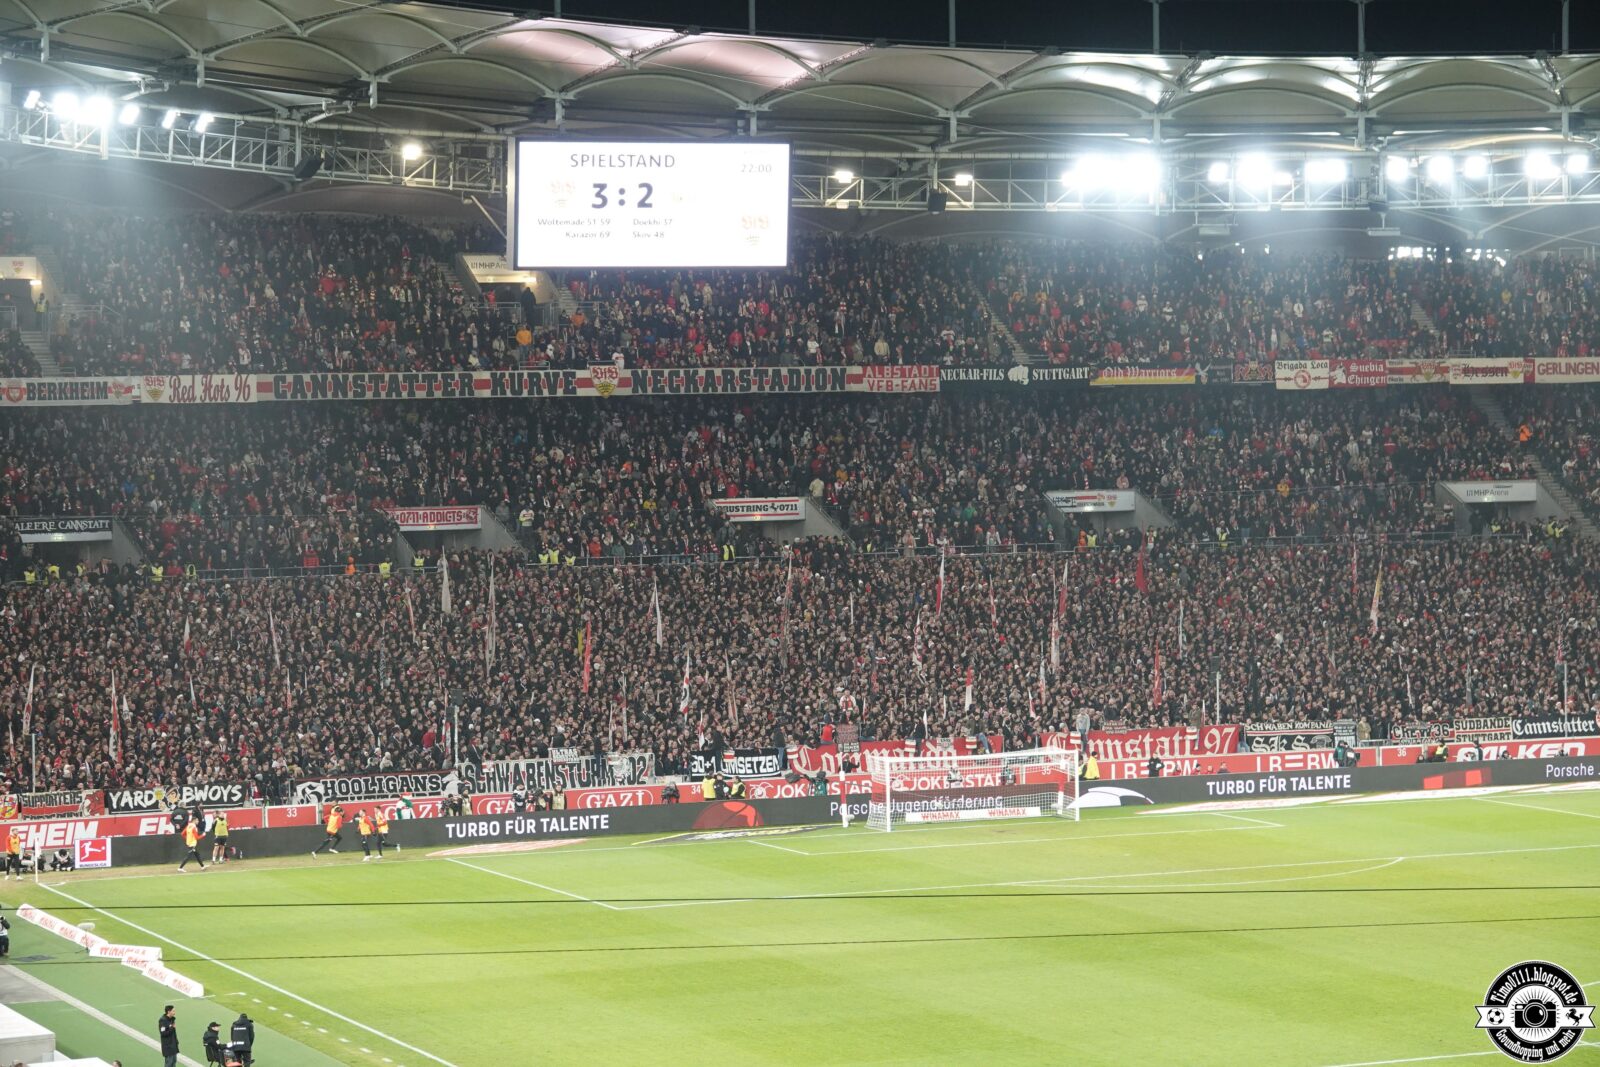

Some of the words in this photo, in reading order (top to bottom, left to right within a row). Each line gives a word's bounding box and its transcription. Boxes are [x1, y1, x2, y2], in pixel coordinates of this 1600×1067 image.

[570, 153, 676, 168] SPIELSTAND
[741, 163, 772, 174] 22:00
[865, 365, 939, 378] ALBSTADT
[1126, 365, 1177, 380] Warriors
[1276, 361, 1308, 371] Brigada
[1310, 361, 1329, 370] Loca
[1537, 362, 1600, 375] GERLINGEN
[631, 367, 847, 394] NECKARSTADION
[940, 368, 1004, 381] NECKAR-FILS
[1032, 367, 1090, 381] STUTTGART
[26, 381, 109, 401] BERKHEIM
[168, 375, 195, 404] Red
[201, 376, 231, 403] Hots
[234, 375, 251, 402] 96
[273, 372, 475, 400] CANNSTATTER
[491, 370, 577, 397] KURVE
[867, 378, 937, 391] VFB-FANS
[780, 503, 798, 511] 0711
[422, 510, 462, 523] ADDICTS
[58, 519, 110, 531] CANNSTATT
[1245, 721, 1293, 731] SCHWABEN
[1204, 727, 1236, 755] 97
[1456, 731, 1512, 743] STUTTGART
[1397, 747, 1407, 757] 36
[720, 755, 780, 774] UMSETZEN
[1546, 763, 1595, 778] Porsche
[321, 774, 442, 797] HOOLIGANS
[1206, 778, 1256, 796] TURBO
[1259, 775, 1287, 793] FÜR
[1290, 774, 1352, 792] TALENTE
[109, 790, 155, 809] YARD
[182, 784, 243, 803] BWOYS
[286, 807, 297, 818] 33
[921, 811, 960, 821] WINAMAX
[988, 808, 1026, 817] WINAMAX
[446, 820, 500, 839] TURBO
[505, 816, 536, 835] FÜR
[540, 814, 610, 833] TALENTE
